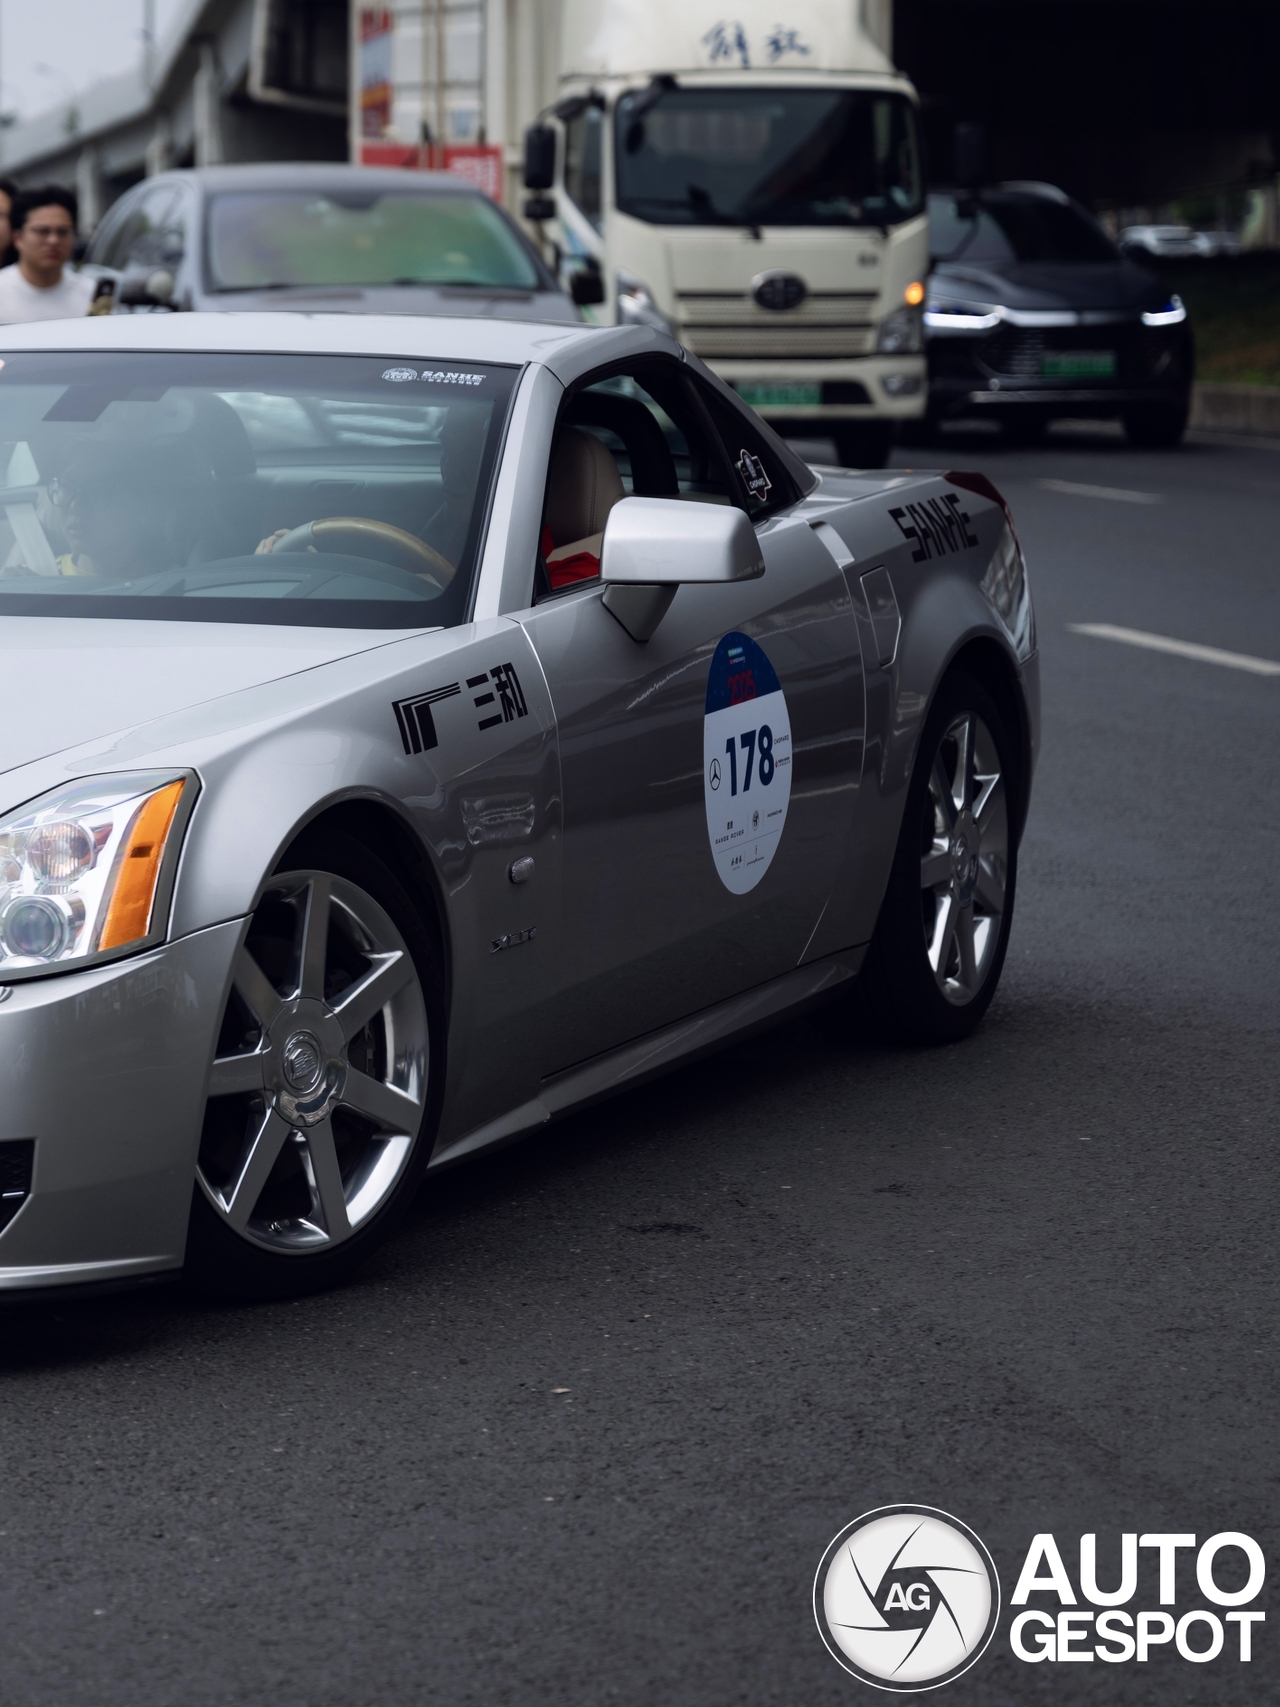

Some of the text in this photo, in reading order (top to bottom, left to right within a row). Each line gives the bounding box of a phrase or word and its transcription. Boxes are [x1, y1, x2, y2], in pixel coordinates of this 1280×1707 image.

[422, 370, 484, 380] SANHE
[466, 662, 528, 731] 三和
[725, 724, 775, 797] 178
